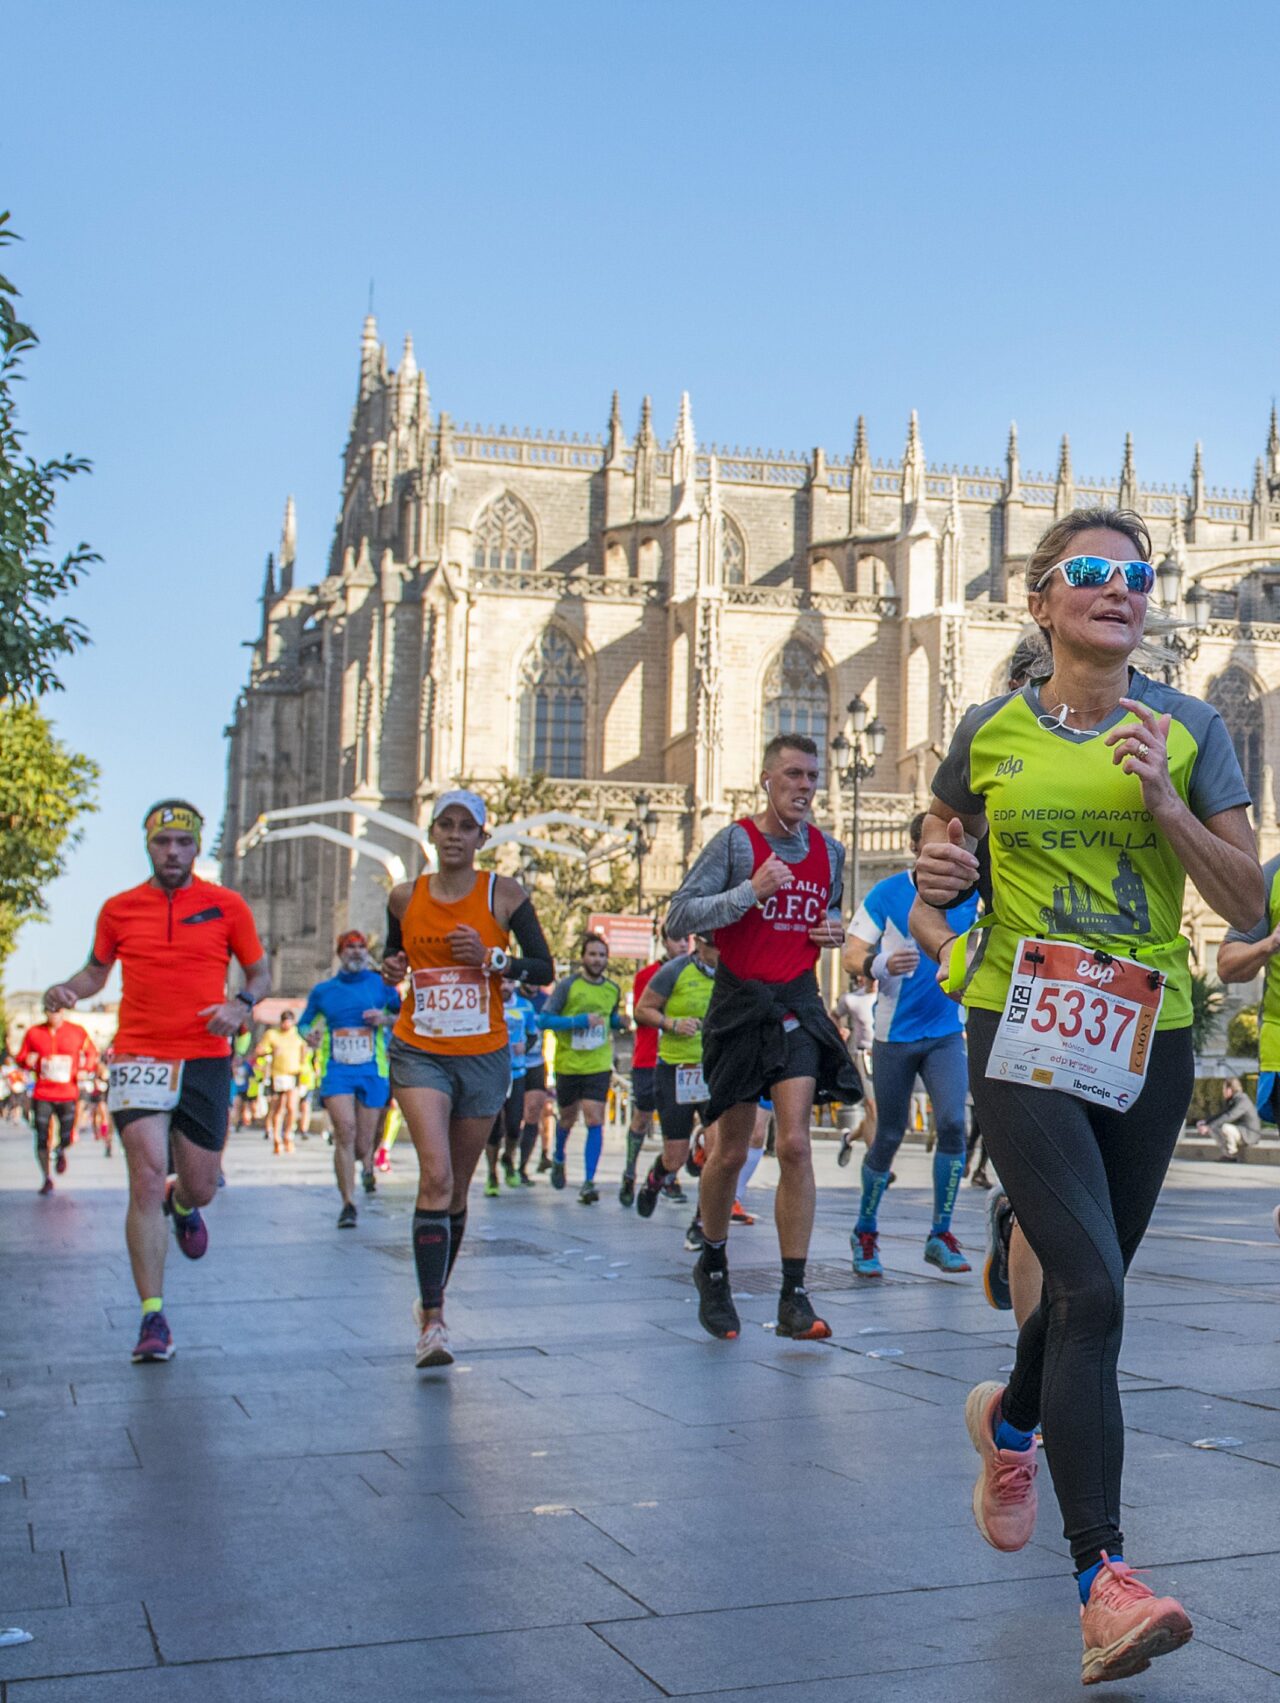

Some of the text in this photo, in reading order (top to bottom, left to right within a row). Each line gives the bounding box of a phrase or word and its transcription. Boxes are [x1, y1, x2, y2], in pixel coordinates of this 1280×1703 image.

[994, 755, 1023, 778] edp
[994, 809, 1154, 822] EDP MEDIO MARATÓ
[1001, 830, 1157, 850] DE SEVILLA
[796, 880, 819, 894] ALL
[1076, 959, 1115, 987] edp
[426, 988, 478, 1011] 4528
[1031, 987, 1136, 1053] 5337
[1134, 1024, 1150, 1069] CAJÓN
[119, 1065, 169, 1086] 5252
[685, 1071, 702, 1086] 77
